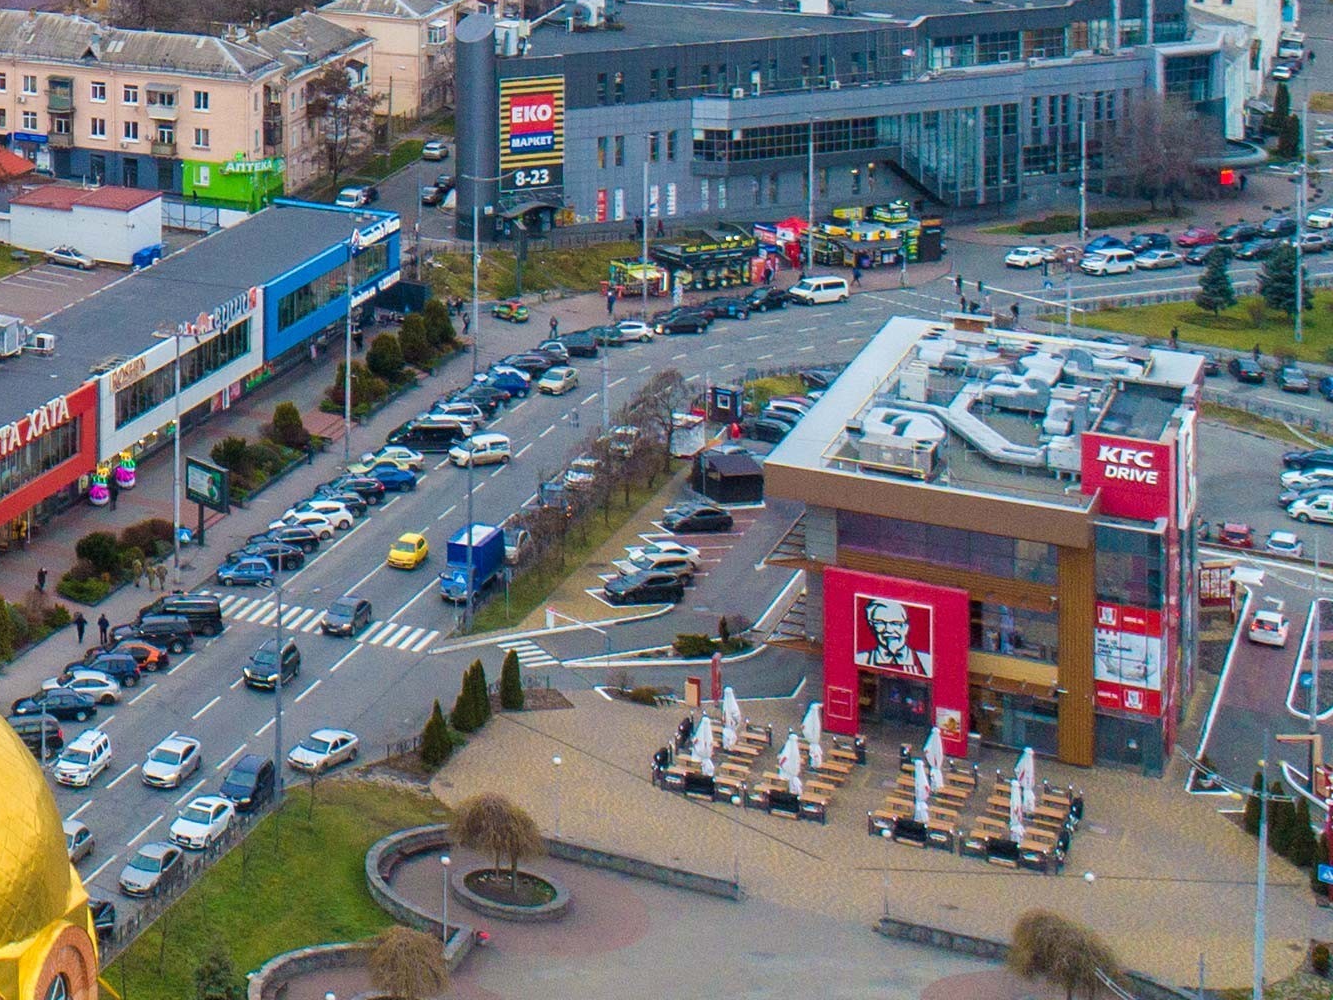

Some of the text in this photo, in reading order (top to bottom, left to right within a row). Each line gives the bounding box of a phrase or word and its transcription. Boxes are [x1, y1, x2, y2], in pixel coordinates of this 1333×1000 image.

[511, 103, 553, 124] ЕКО
[511, 135, 553, 148] МАРКЕТ
[225, 159, 273, 172] АПТЕКА
[515, 168, 550, 187] 8-23
[26, 395, 70, 442] ХАТА
[1096, 445, 1154, 468] KFC
[1104, 464, 1159, 485] DRIVE
